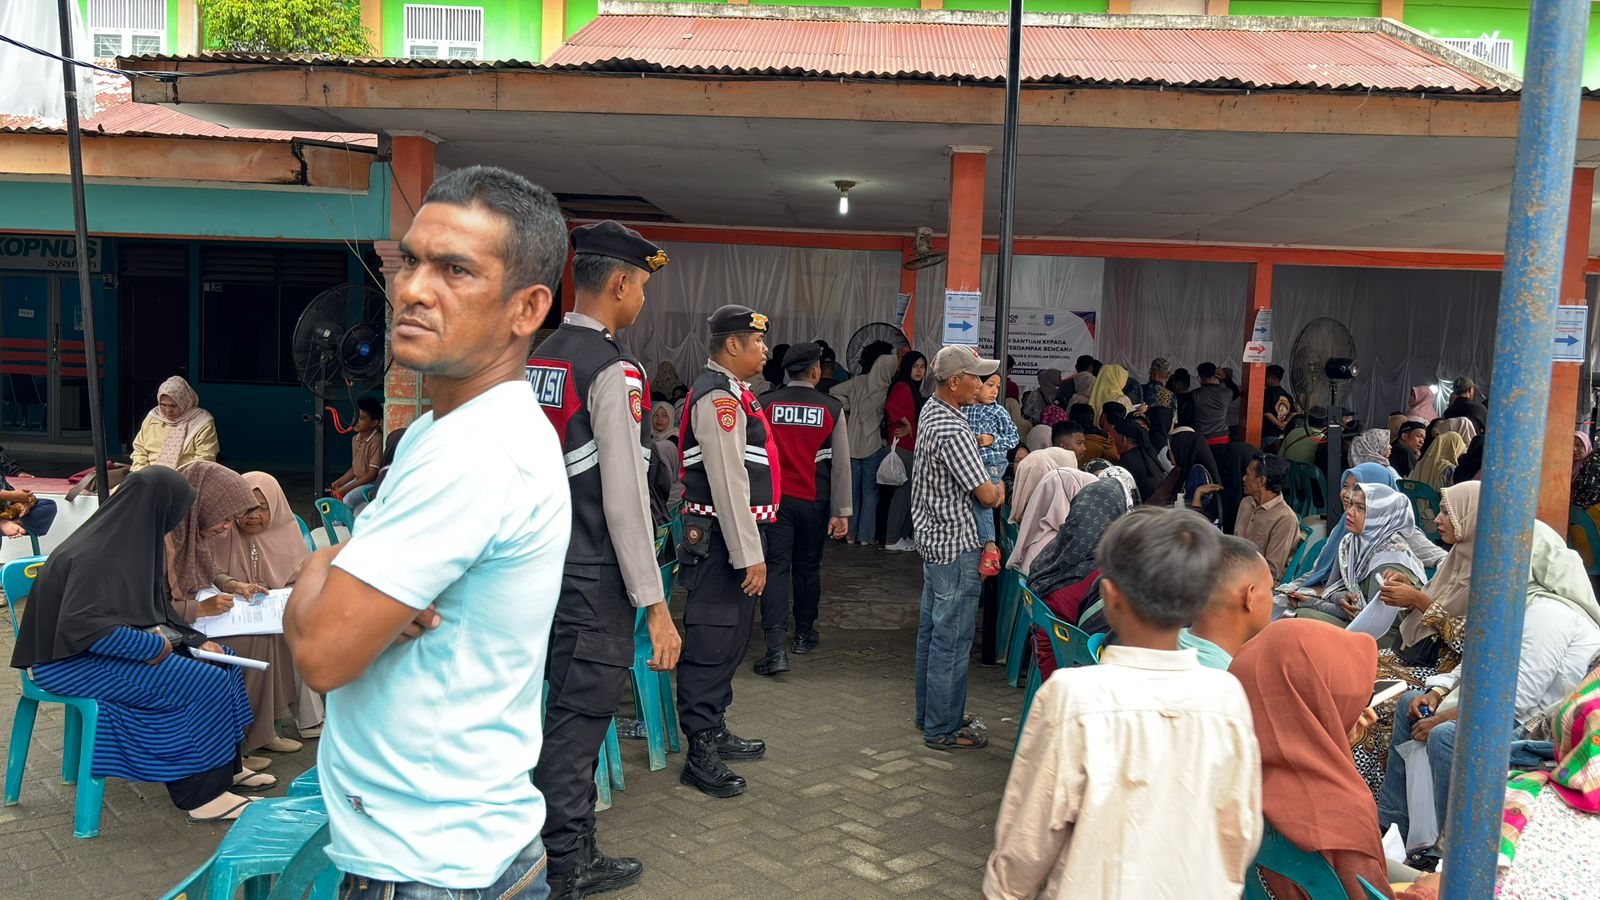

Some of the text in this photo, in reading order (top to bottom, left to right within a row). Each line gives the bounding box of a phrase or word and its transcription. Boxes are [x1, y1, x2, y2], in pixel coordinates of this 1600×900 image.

[0, 238, 97, 258] OPNUS
[47, 258, 96, 268] syarh
[774, 406, 821, 425] POLISI
